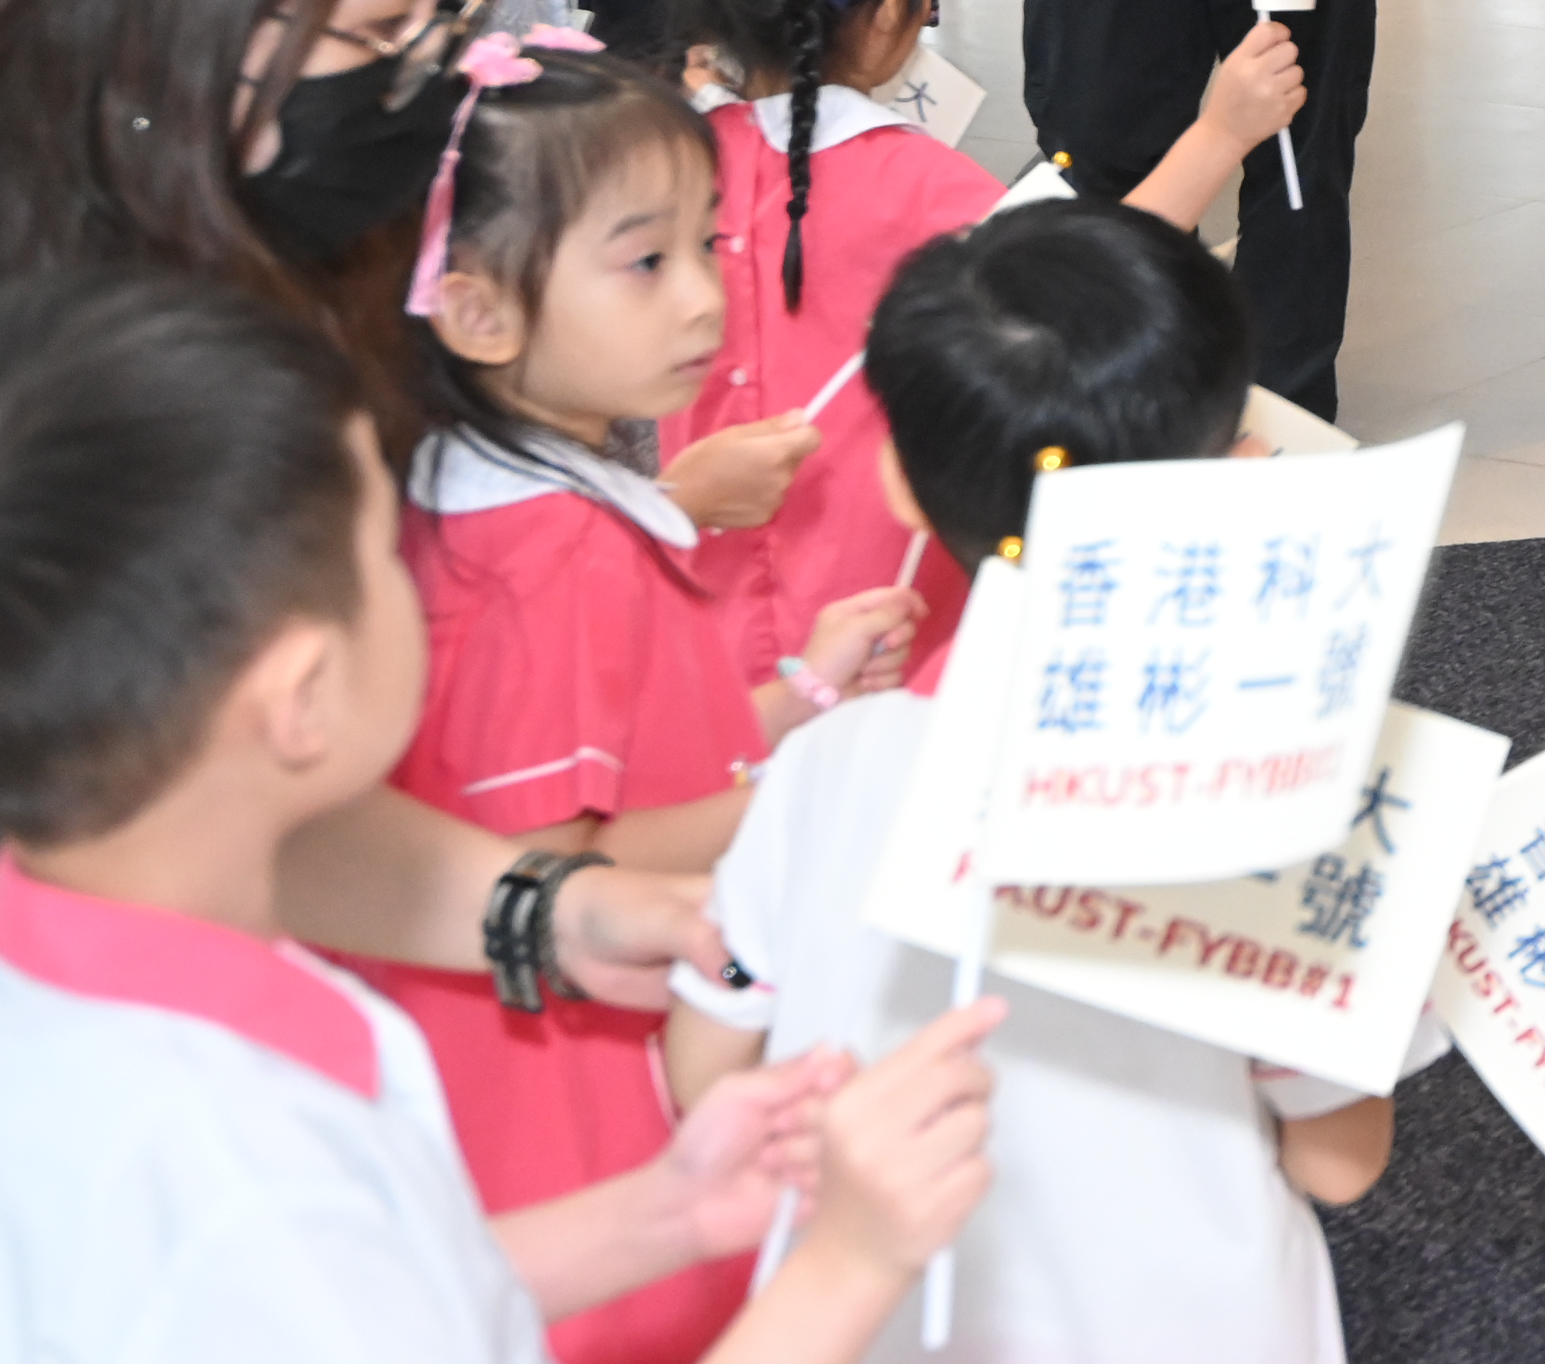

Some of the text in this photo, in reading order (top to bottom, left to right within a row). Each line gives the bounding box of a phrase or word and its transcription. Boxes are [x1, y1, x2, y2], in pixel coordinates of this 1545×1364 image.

[895, 81, 938, 123] 大
[1057, 522, 1394, 628] 香港科大
[1036, 624, 1372, 735] 雄彬一號
[1351, 767, 1413, 854] 大
